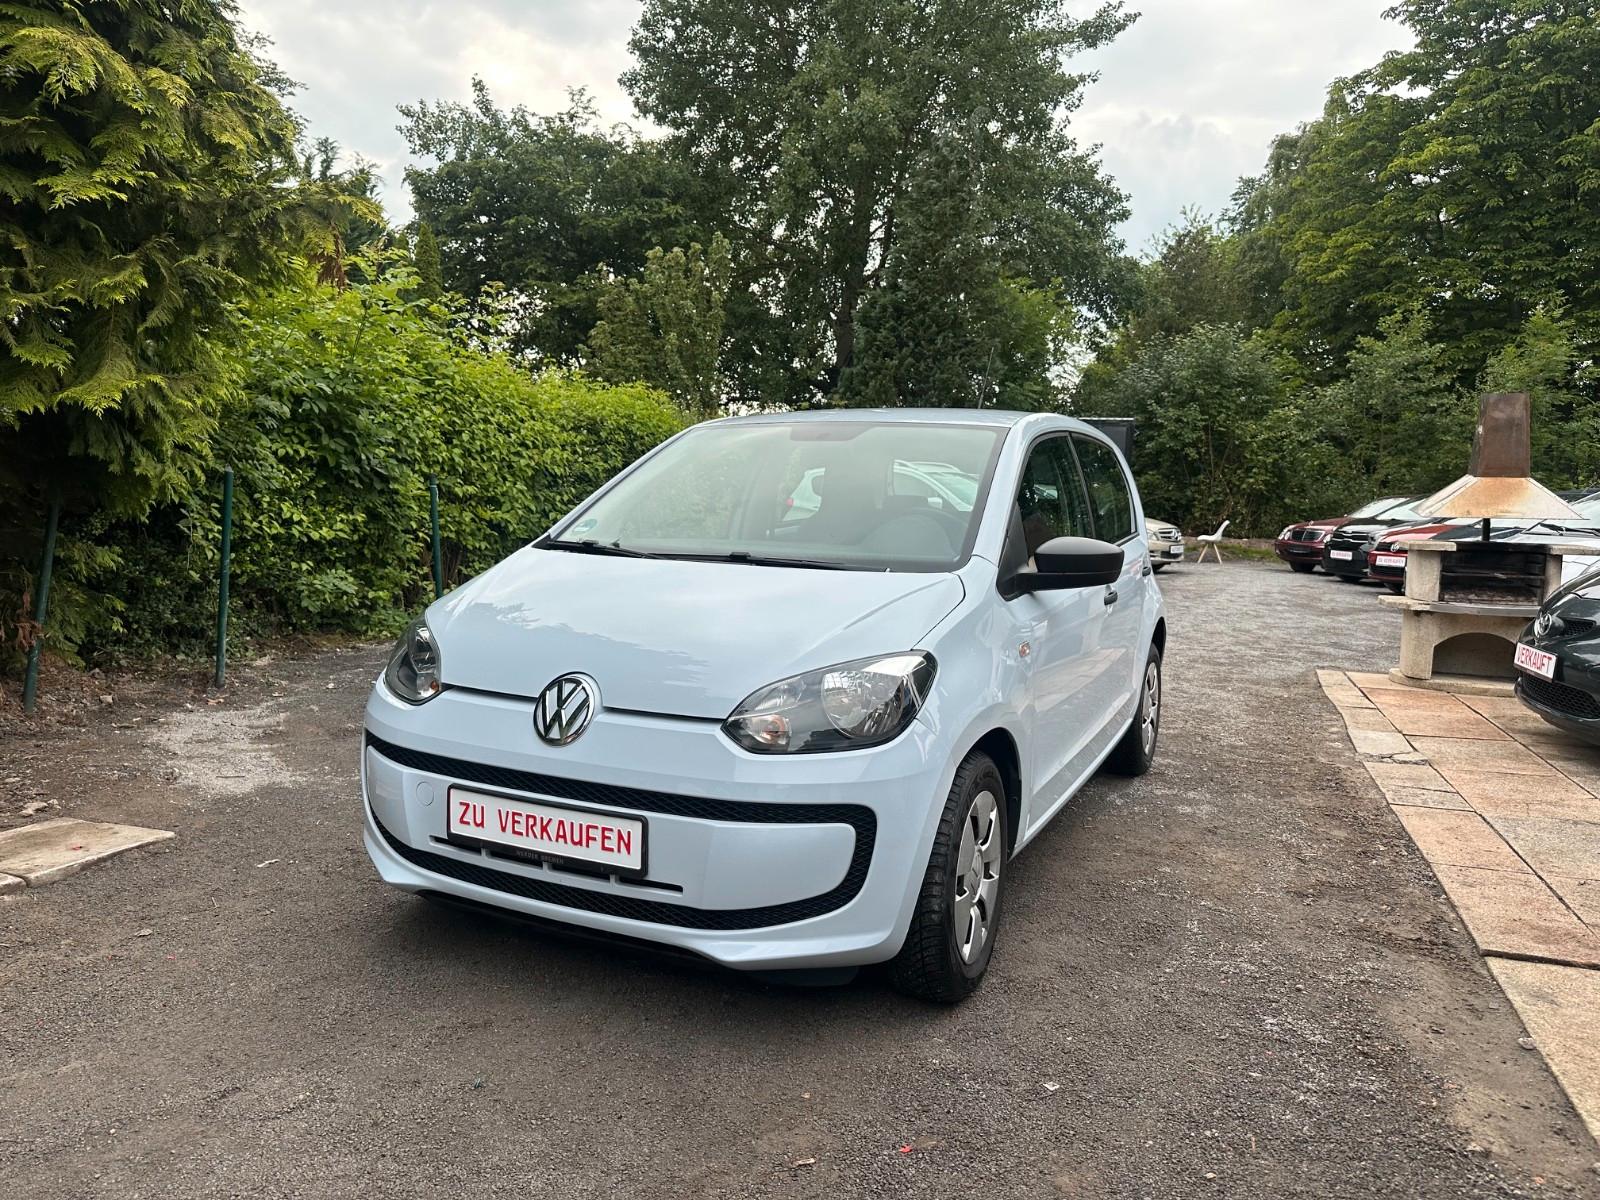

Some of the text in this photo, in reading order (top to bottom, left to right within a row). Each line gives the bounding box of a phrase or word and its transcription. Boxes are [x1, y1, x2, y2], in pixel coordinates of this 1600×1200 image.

[1517, 645, 1553, 674] VERKAUFT
[458, 801, 632, 856] ZU VERKAUFEN
